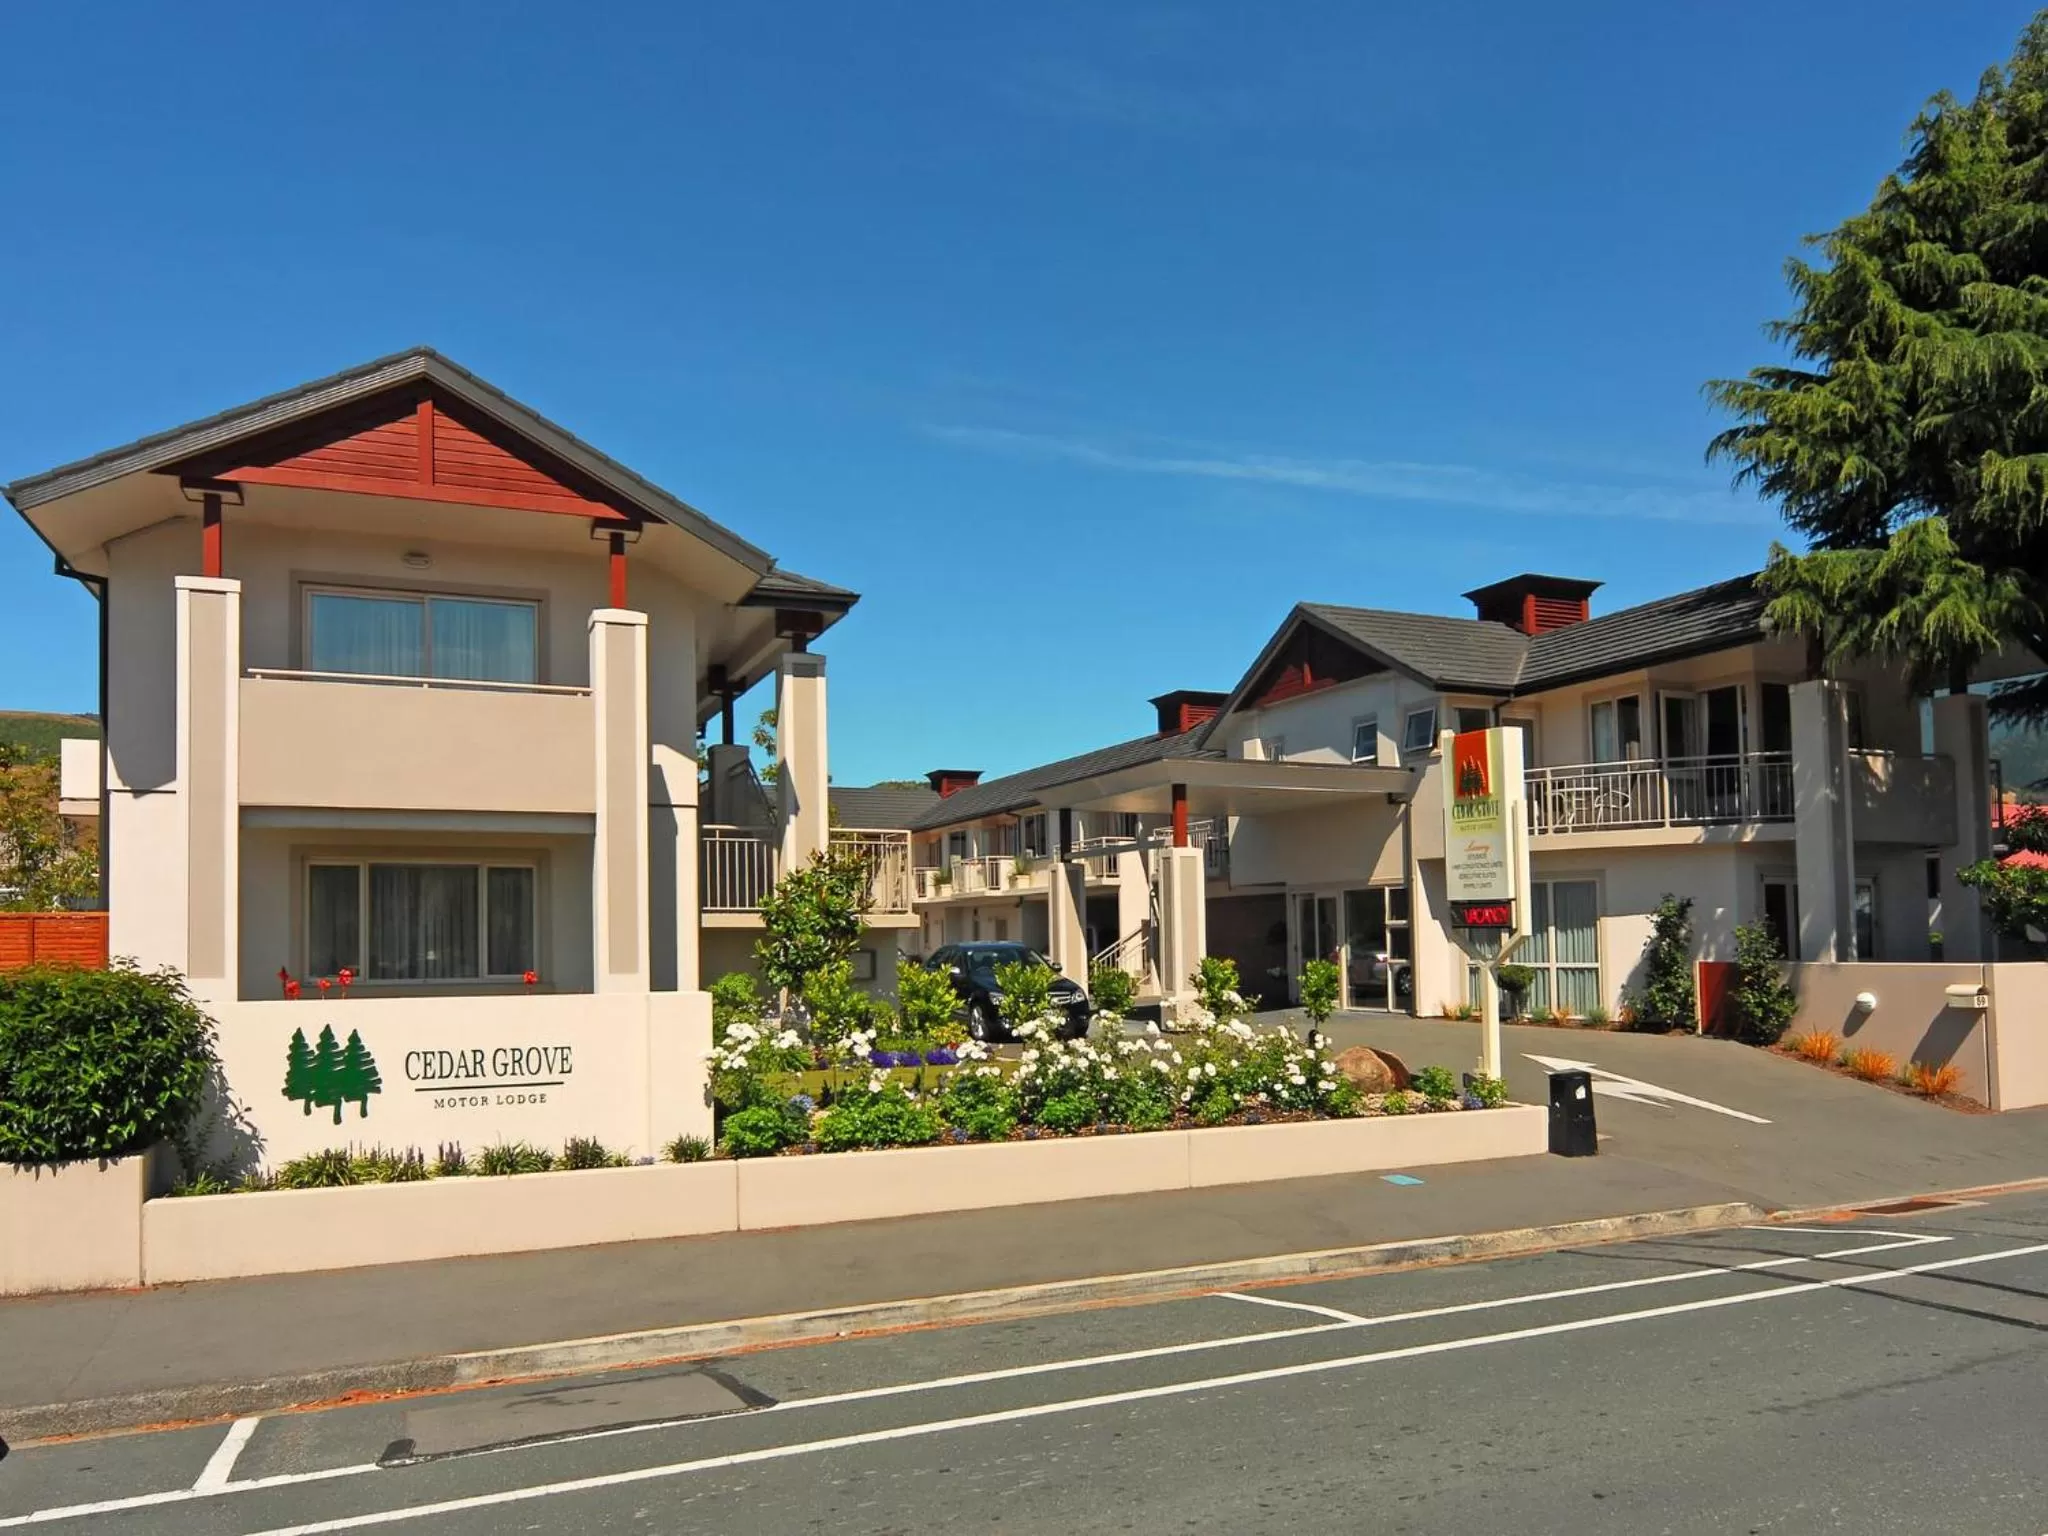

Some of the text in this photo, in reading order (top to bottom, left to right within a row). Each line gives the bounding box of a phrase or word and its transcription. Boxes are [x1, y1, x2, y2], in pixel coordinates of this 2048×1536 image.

[1464, 906, 1509, 925] VACANCY
[405, 1046, 573, 1081] CEDAR GROVE
[434, 1093, 548, 1109] MOTOR LODGE
